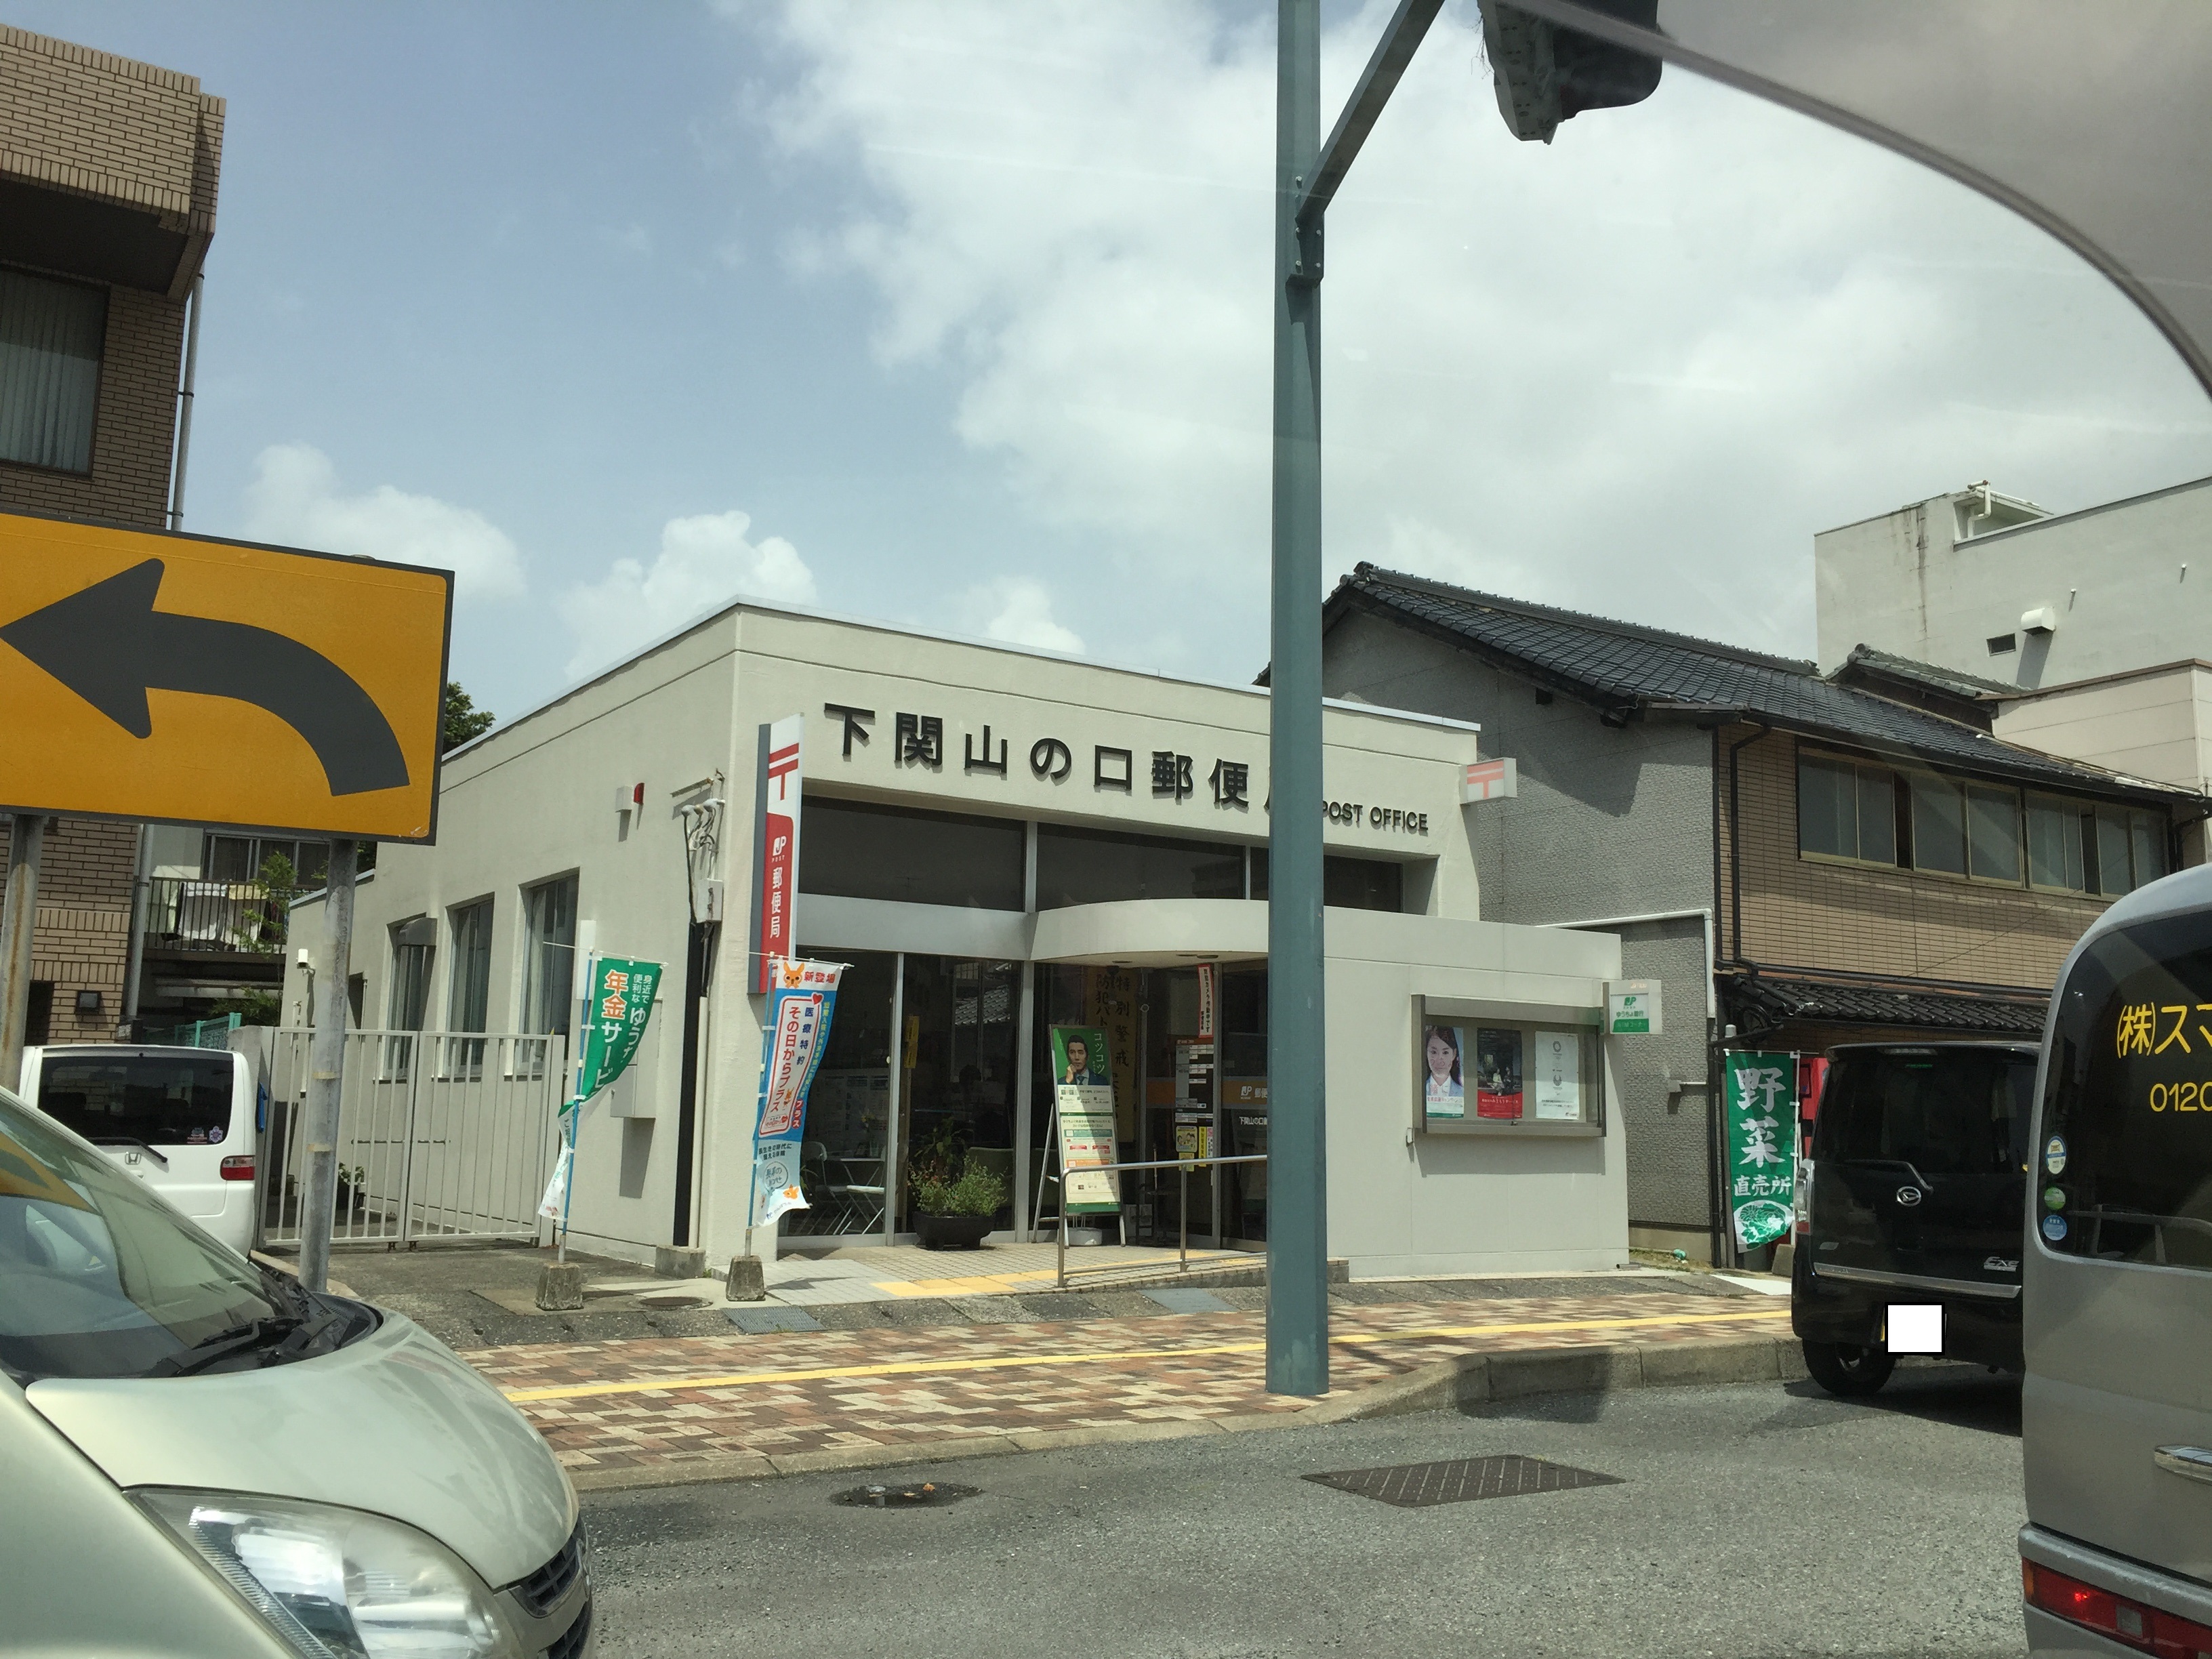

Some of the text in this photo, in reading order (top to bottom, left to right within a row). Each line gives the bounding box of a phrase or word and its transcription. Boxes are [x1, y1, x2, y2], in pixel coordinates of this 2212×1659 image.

[824, 703, 1269, 811] 下関山の口郵便
[1370, 806, 1428, 831] OFFICE
[770, 867, 783, 939] 郵便局
[631, 974, 643, 1003] 便利な
[642, 975, 653, 1004] 身近で
[804, 971, 836, 984] 新登場
[594, 969, 629, 1089] 年金サービ
[796, 1007, 815, 1065] 医療特約
[771, 1006, 801, 1112] その日からプラス
[1094, 1033, 1105, 1075] コツコツ
[792, 1099, 804, 1128] プラス
[2150, 1082, 2212, 1112] 0120
[1734, 1067, 1786, 1168] 野菜
[1734, 1174, 1793, 1197] 直売所
